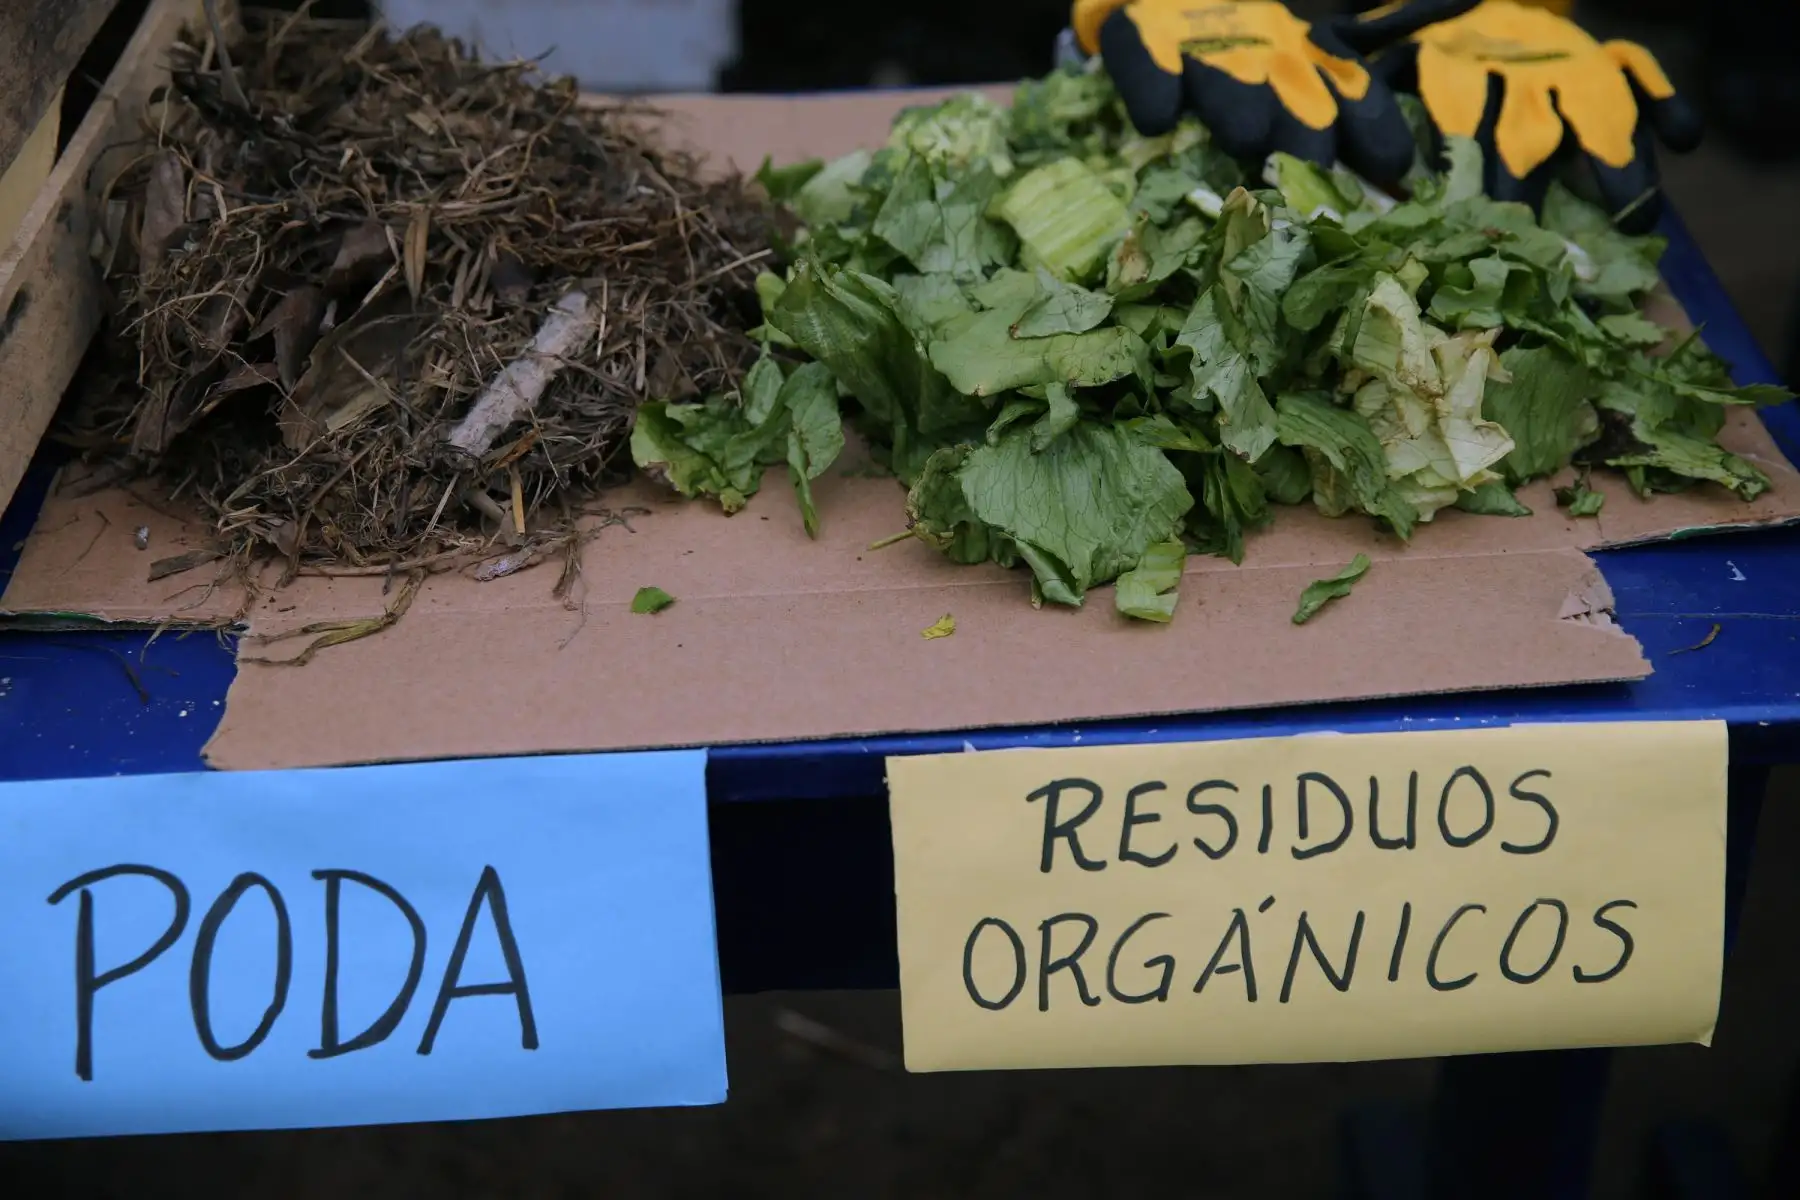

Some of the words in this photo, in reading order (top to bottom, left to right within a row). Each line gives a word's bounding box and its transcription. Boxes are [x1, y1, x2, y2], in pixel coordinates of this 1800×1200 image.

[1026, 766, 1559, 873] RESIDUOS
[47, 864, 539, 1081] PODA
[963, 896, 1637, 1012] ORGÁNICOS
